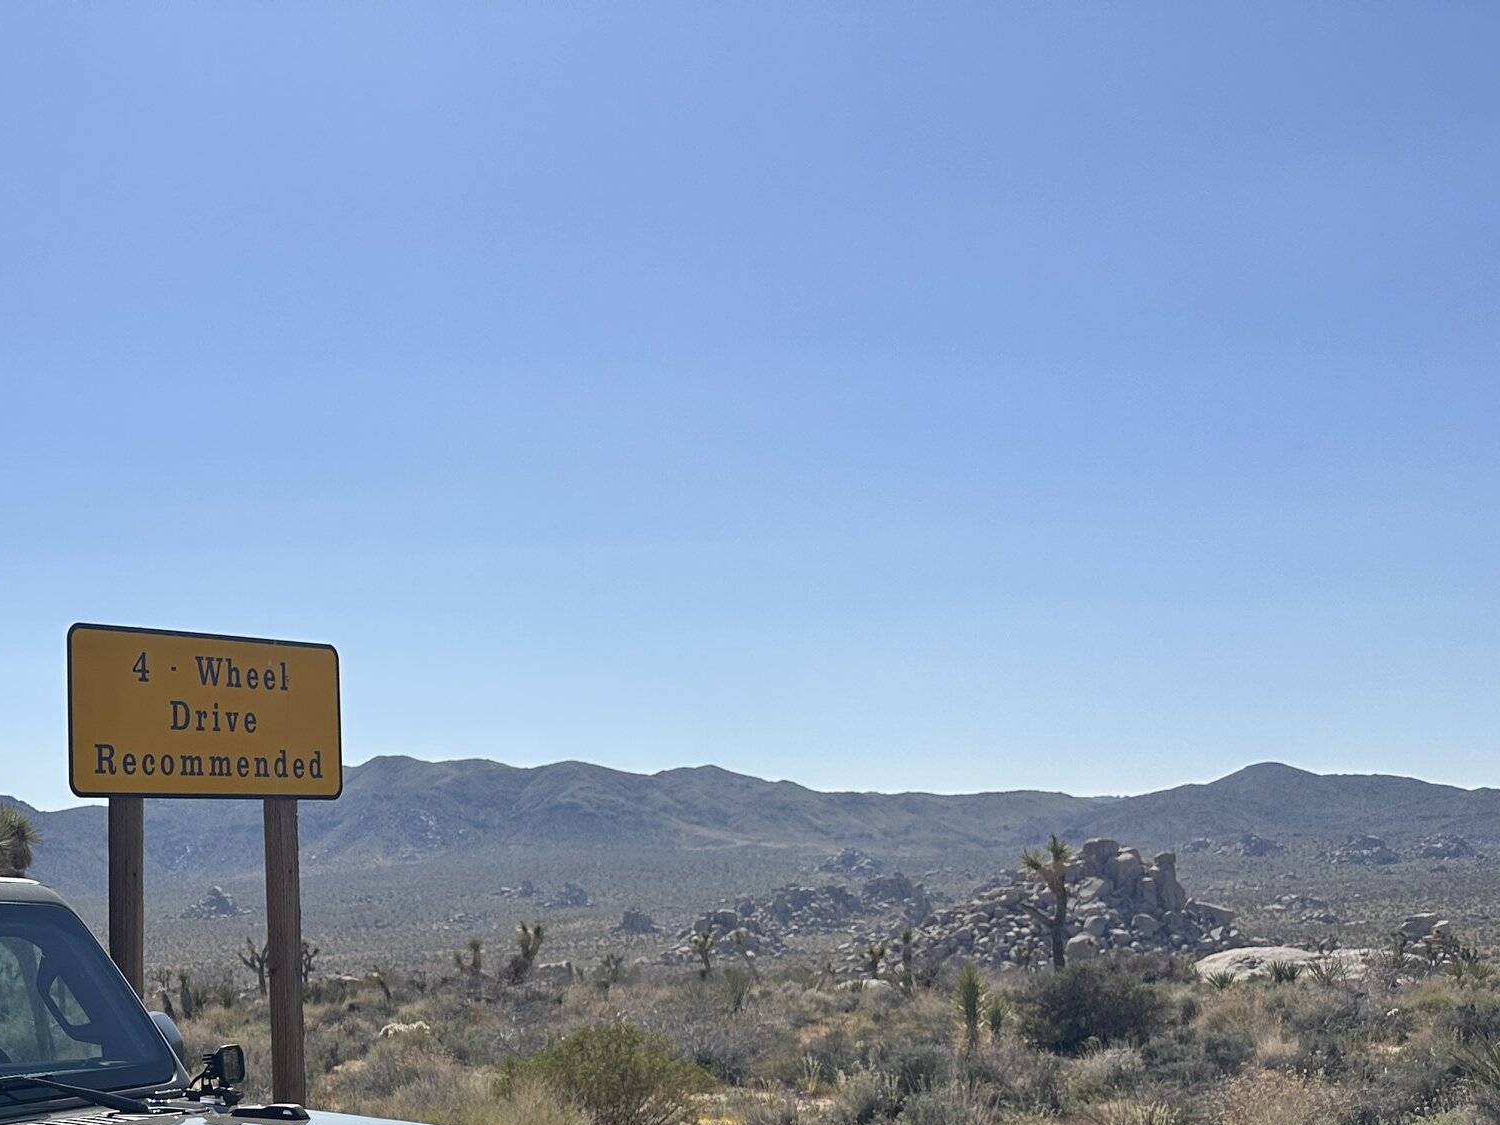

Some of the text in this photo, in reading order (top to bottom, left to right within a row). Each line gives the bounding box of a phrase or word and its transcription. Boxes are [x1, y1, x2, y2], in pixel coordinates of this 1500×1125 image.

[132, 652, 150, 683] 4
[195, 656, 290, 691] Wheel
[170, 700, 258, 734] Drive
[94, 743, 324, 780] Recommended
